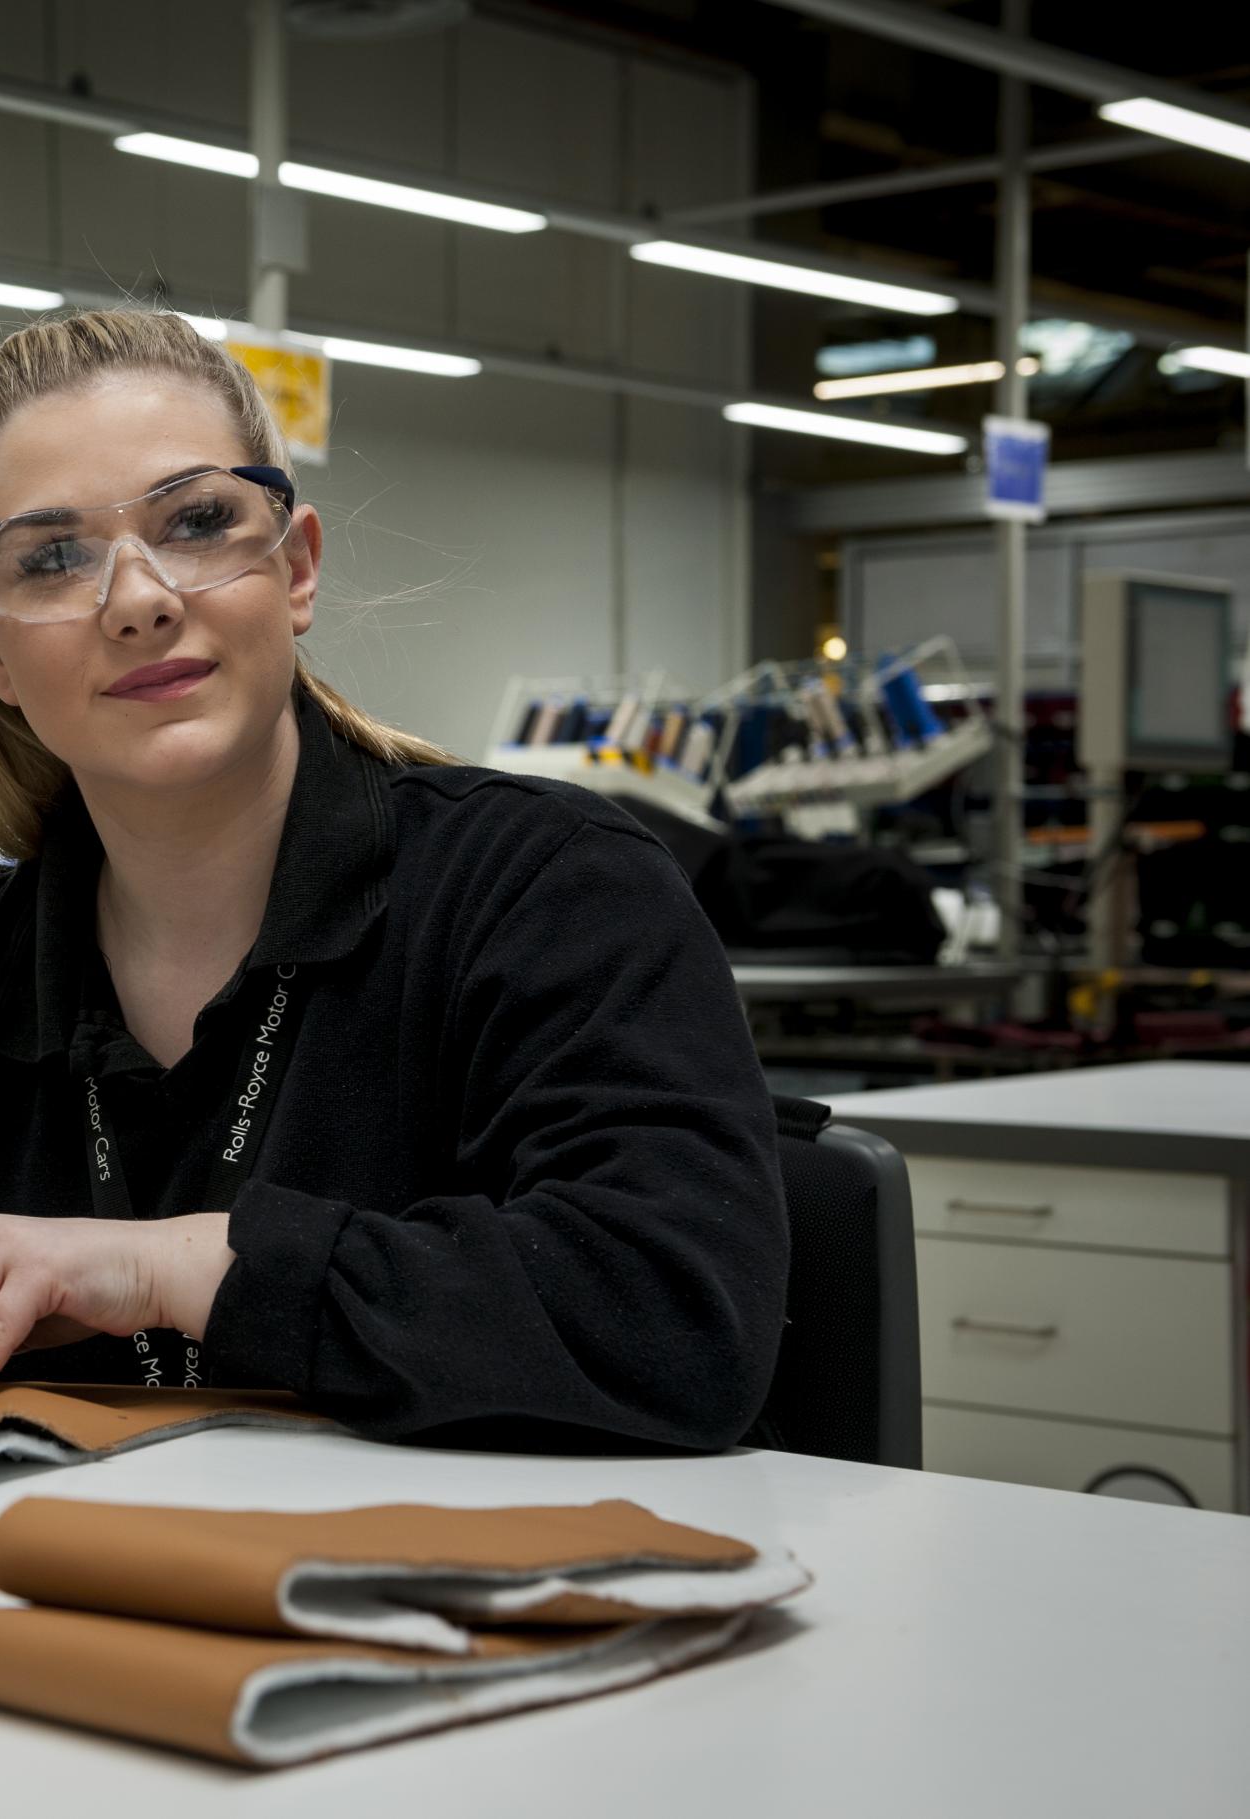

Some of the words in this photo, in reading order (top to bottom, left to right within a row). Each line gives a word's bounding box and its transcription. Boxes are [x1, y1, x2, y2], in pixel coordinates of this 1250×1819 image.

[223, 1051, 270, 1162] Rolls-Royce
[256, 984, 289, 1045] Motor
[277, 964, 296, 979] C
[85, 1076, 101, 1132] Motor
[95, 1137, 110, 1180] Cars
[133, 1331, 150, 1353] ce
[141, 1357, 162, 1388] Mo
[183, 1347, 202, 1389] oyce
